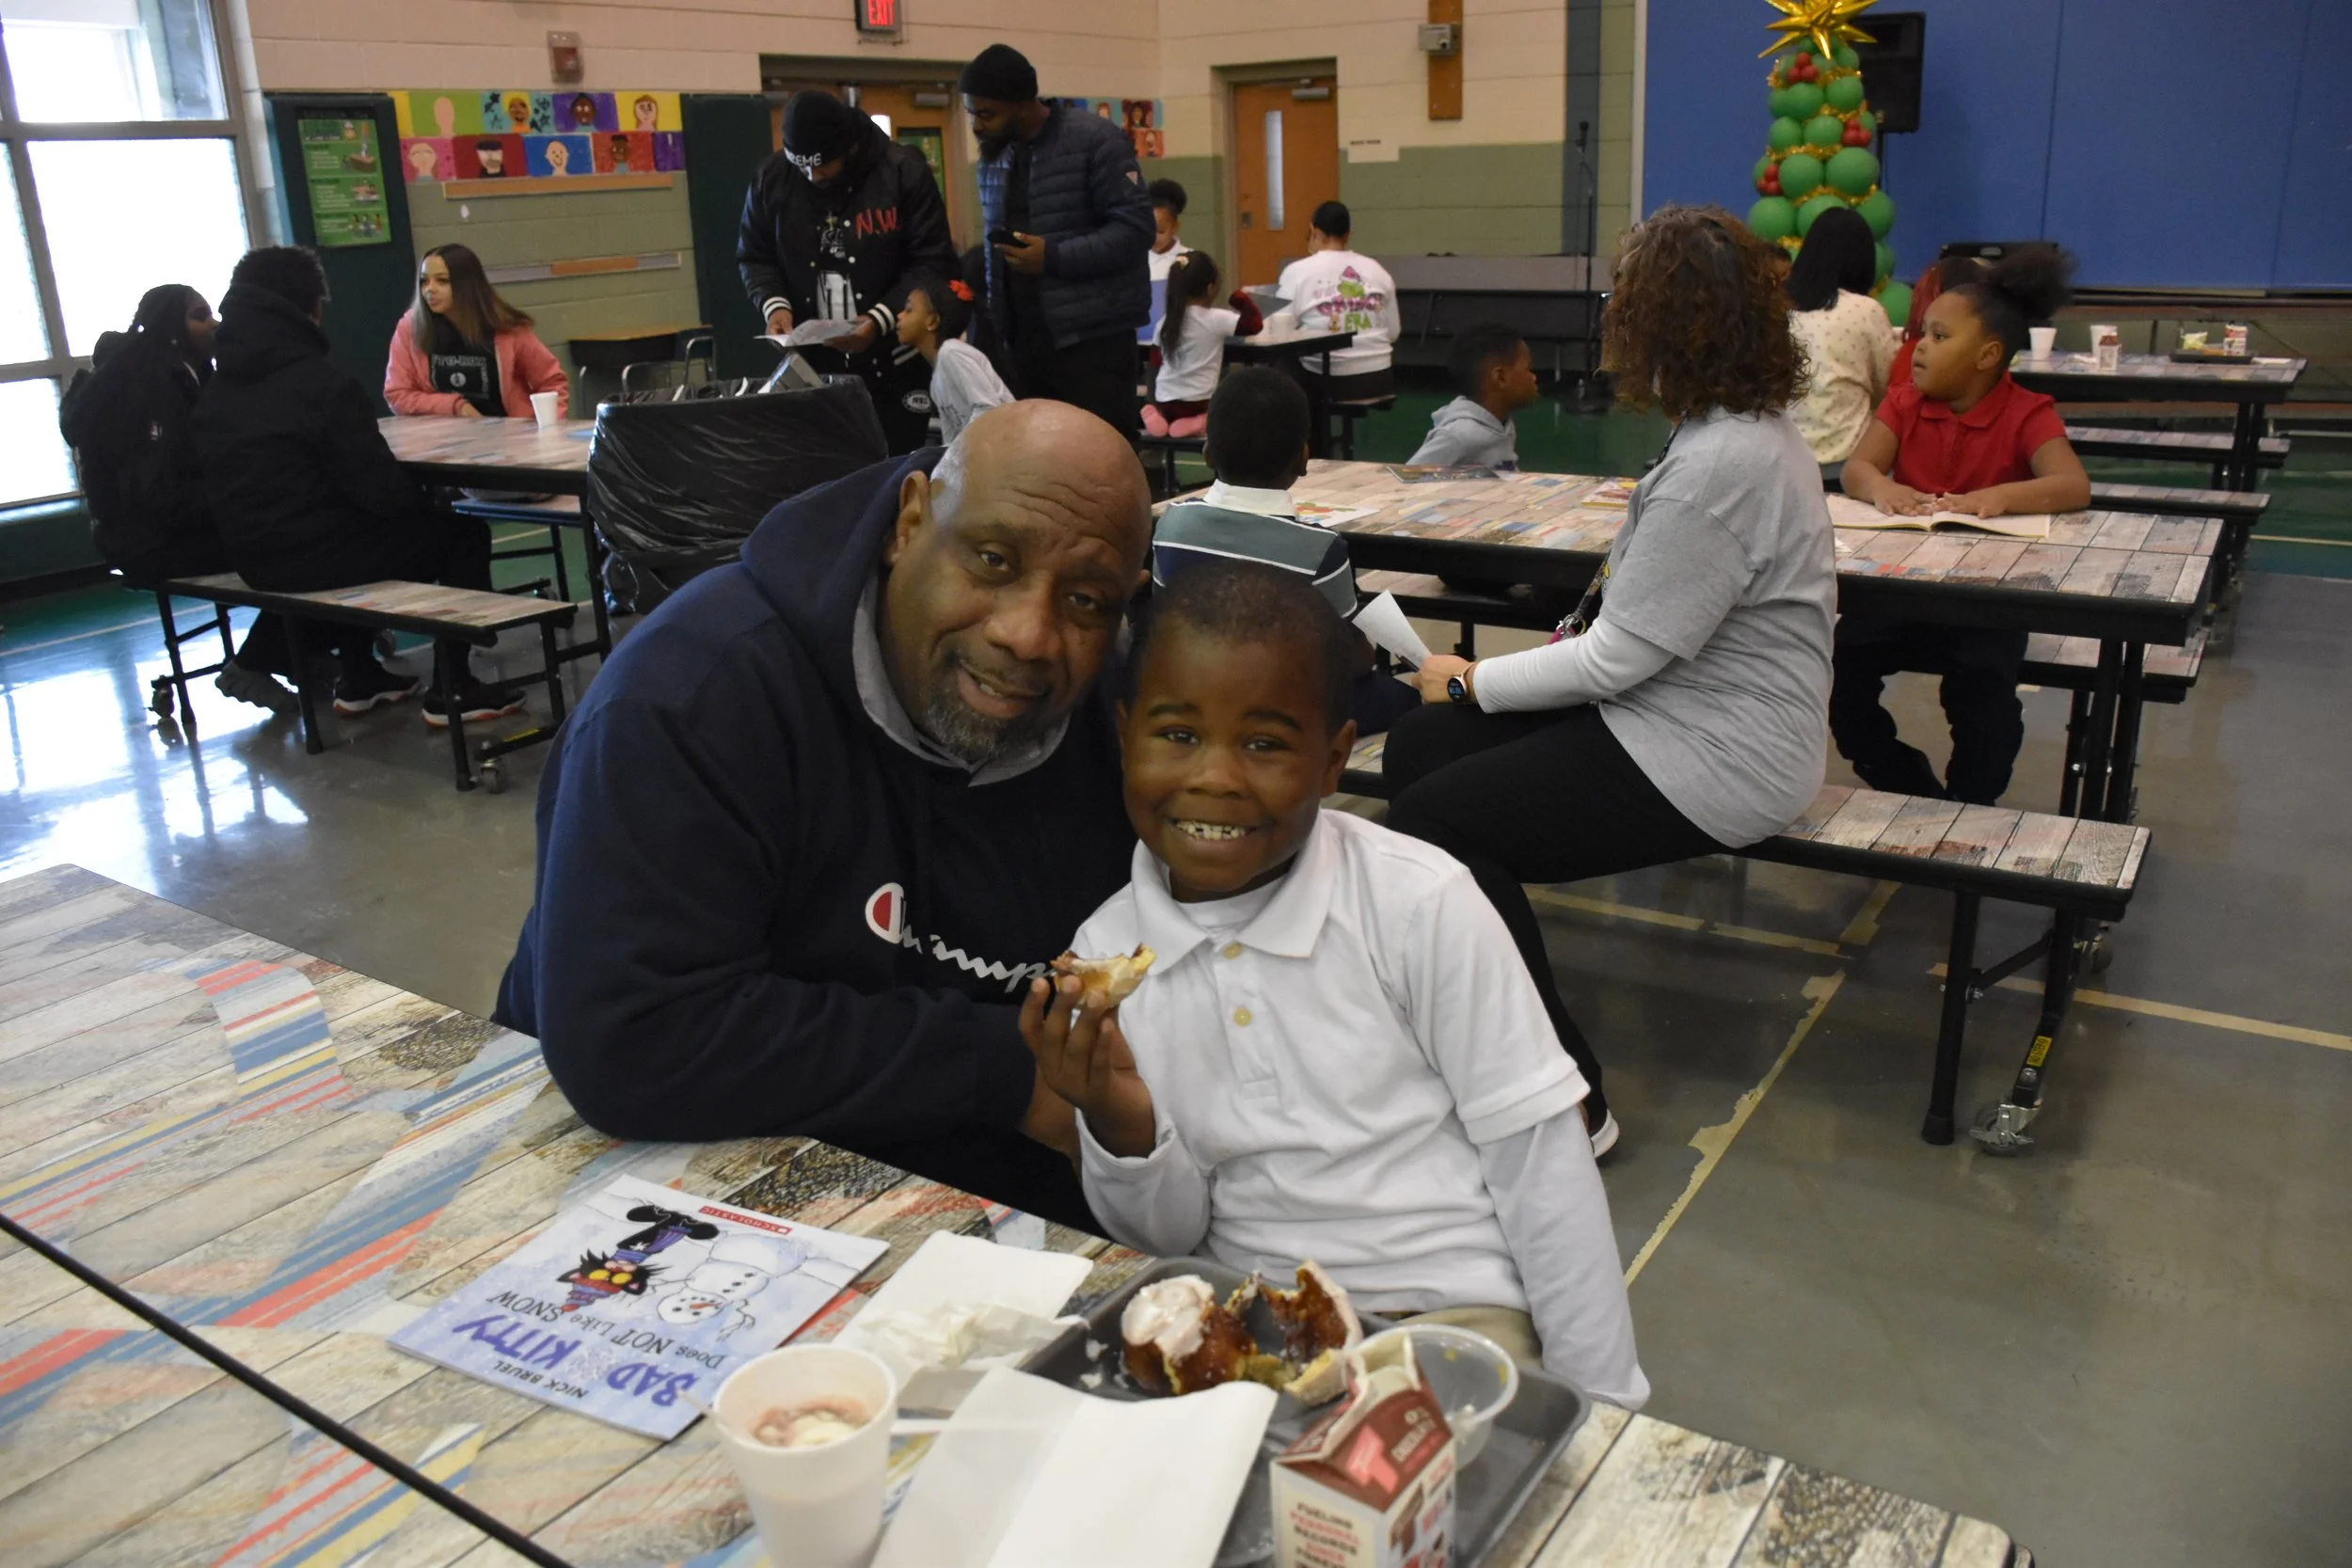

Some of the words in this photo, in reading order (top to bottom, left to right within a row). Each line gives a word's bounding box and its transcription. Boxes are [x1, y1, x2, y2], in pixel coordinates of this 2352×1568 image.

[867, 0, 895, 26] EXIT
[700, 1206, 777, 1232] SCHOLASTIC
[485, 1291, 564, 1323] SNOW
[570, 1313, 617, 1337] Like
[452, 1315, 582, 1370] KITTY
[611, 1328, 675, 1354] NOT
[675, 1345, 727, 1370] Does
[493, 1360, 545, 1384] BRUEL
[607, 1361, 701, 1407] BAD
[544, 1379, 589, 1399] NICK
